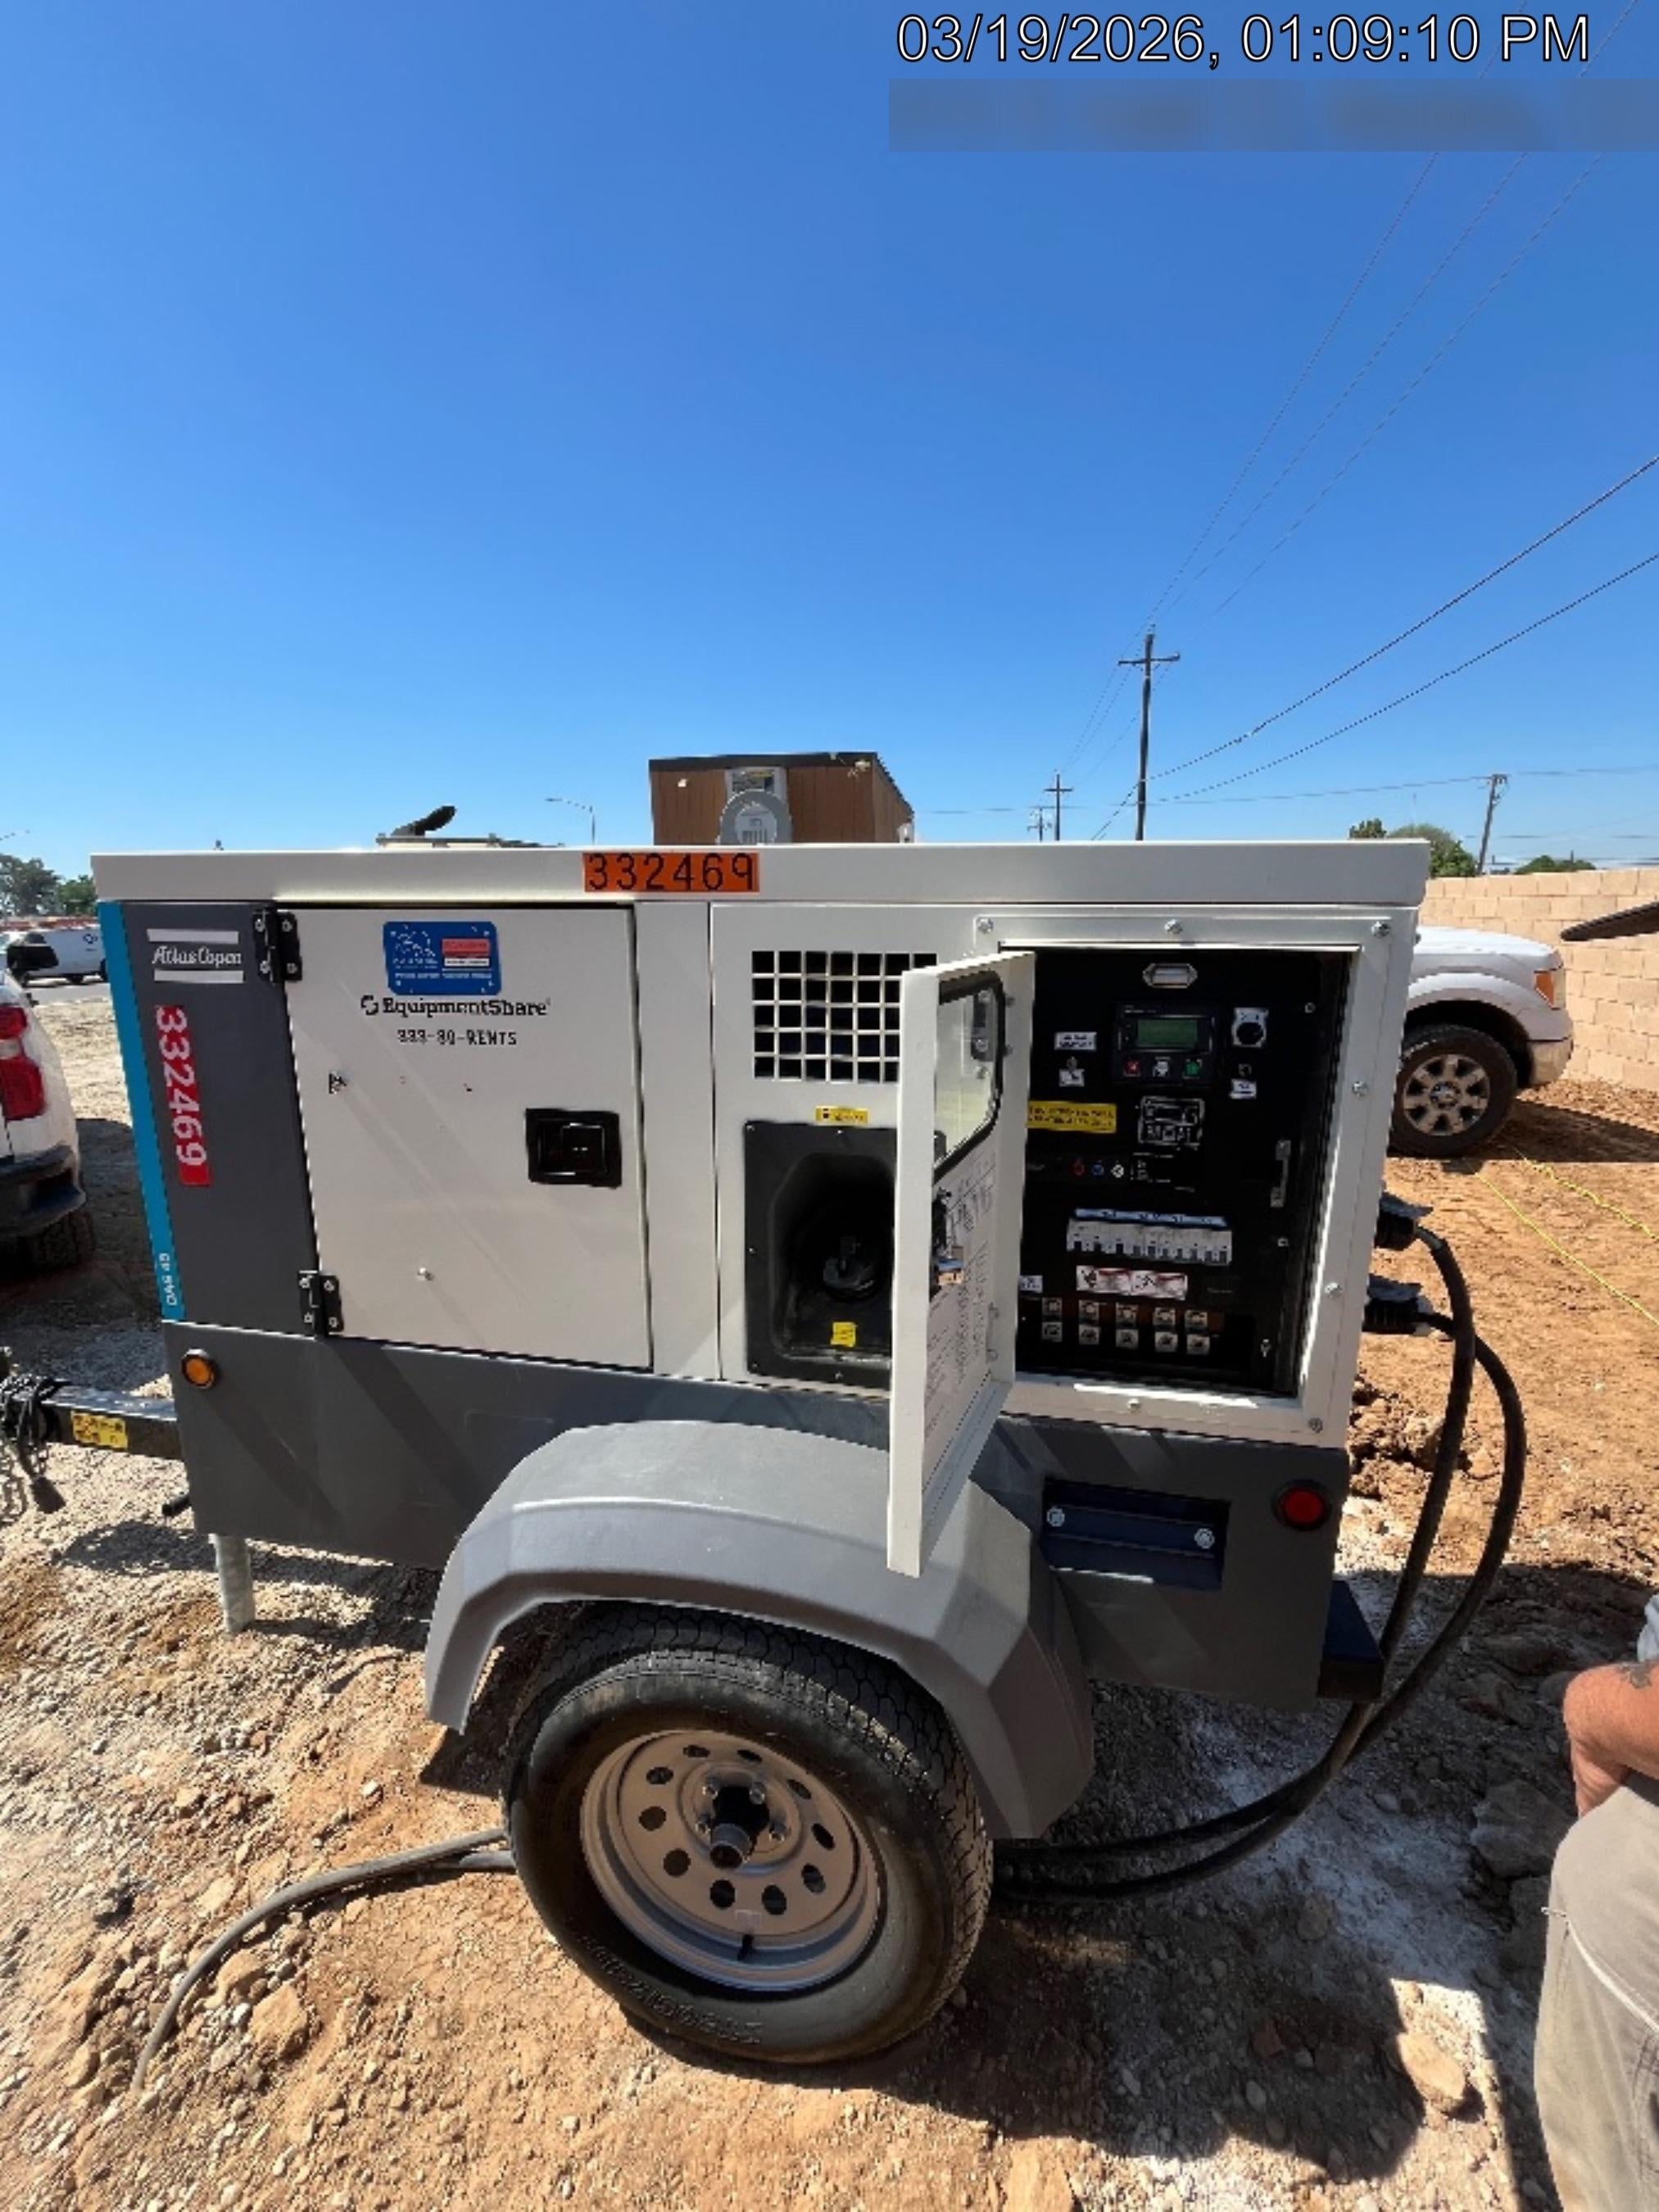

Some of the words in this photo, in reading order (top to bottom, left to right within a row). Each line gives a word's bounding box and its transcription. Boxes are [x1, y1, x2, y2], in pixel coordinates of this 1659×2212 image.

[588, 853, 754, 891] 332469
[152, 945, 197, 965] Atlas
[156, 1006, 207, 1166] 332469
